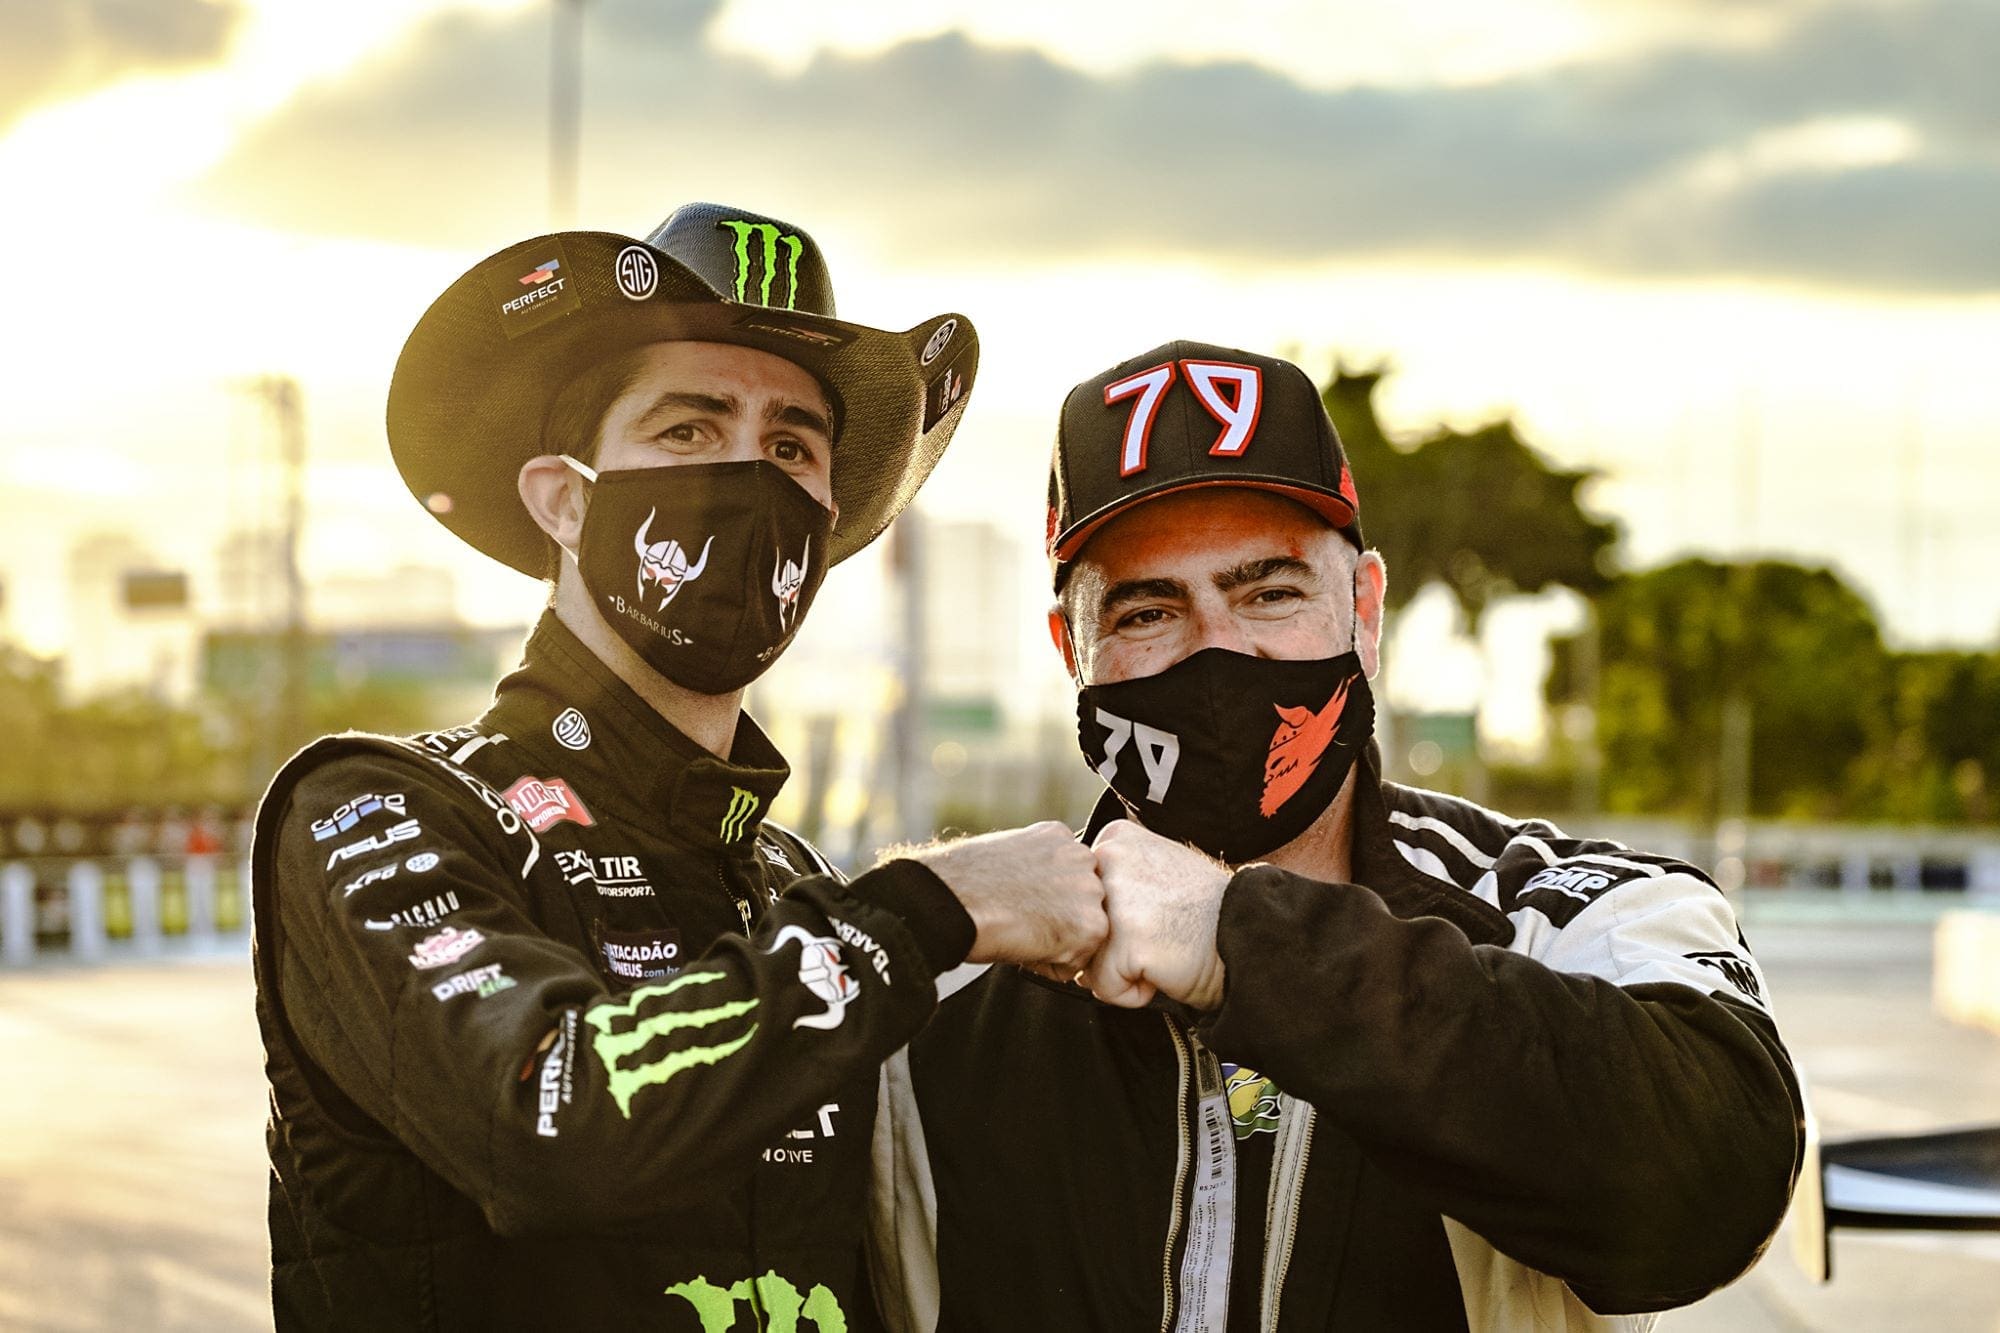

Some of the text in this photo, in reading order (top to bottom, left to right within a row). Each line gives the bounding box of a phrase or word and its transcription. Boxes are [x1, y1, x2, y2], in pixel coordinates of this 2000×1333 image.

[621, 252, 652, 294] SIG
[502, 278, 566, 315] PERFECT
[520, 296, 559, 315] AUTOMOTIVE
[1104, 359, 1262, 477] 79
[616, 595, 683, 646] BARBARIUS
[557, 712, 588, 746] SIG
[1095, 706, 1180, 804] 79
[326, 818, 421, 871] ASUS
[344, 862, 398, 898] XPG
[1524, 867, 1610, 893] OMP
[432, 962, 502, 1001] DRIFT
